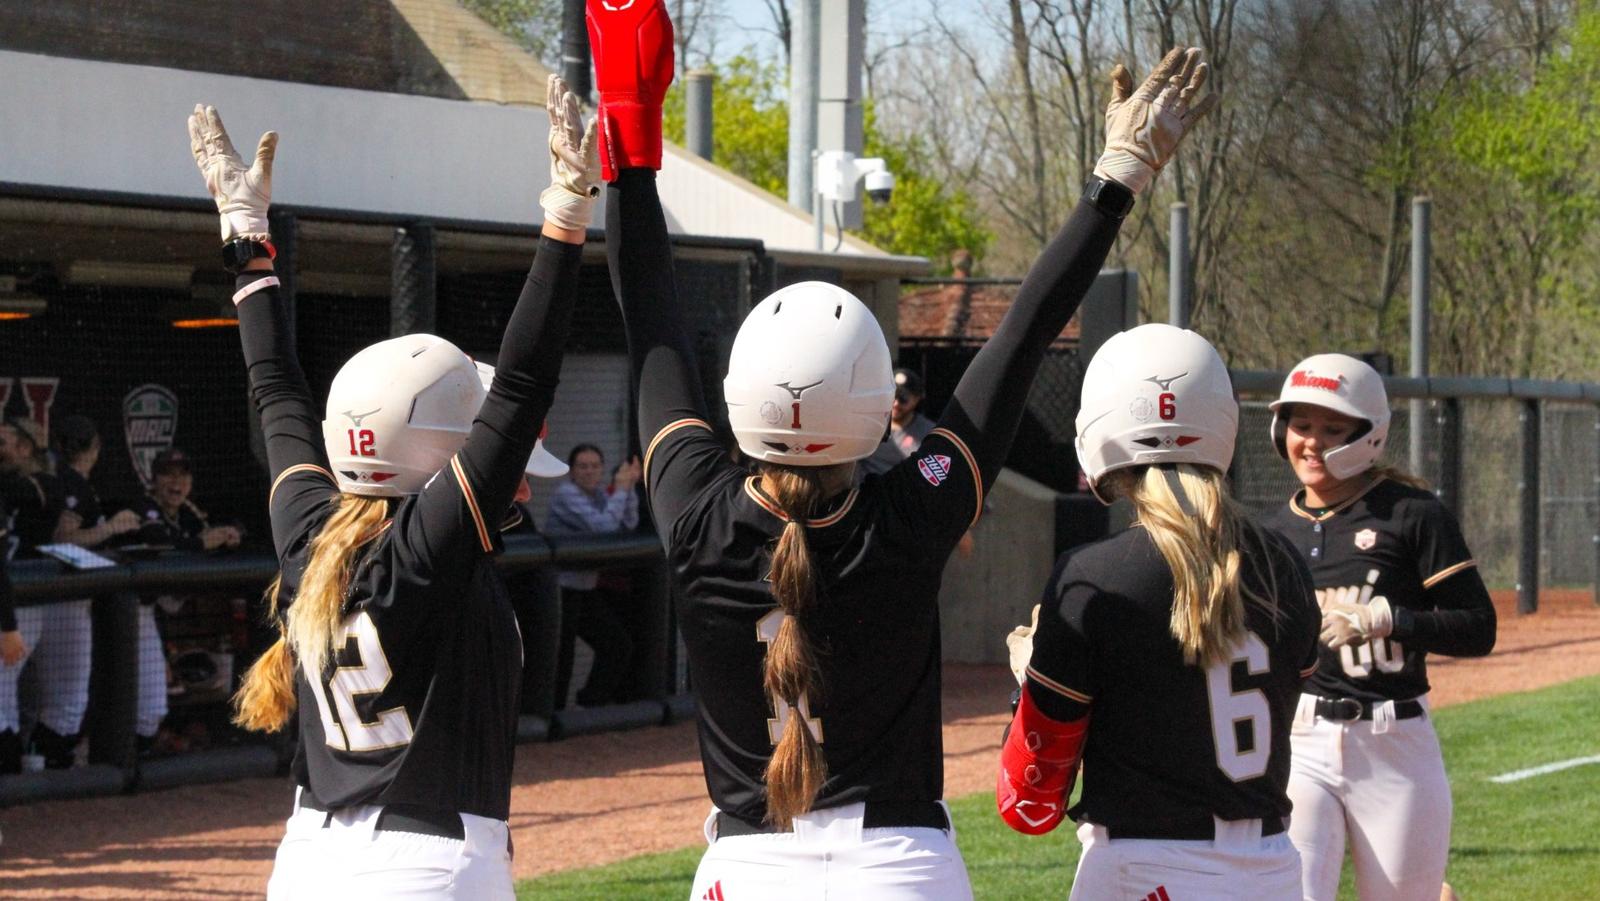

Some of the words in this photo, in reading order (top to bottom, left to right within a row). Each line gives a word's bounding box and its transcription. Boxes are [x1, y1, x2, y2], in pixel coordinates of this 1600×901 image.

[791, 402, 802, 428] 1
[1159, 392, 1176, 420] 6
[130, 419, 172, 443] MAC
[347, 428, 376, 456] 12
[923, 454, 948, 482] MAC
[304, 611, 414, 751] 12
[1205, 629, 1272, 783] 6
